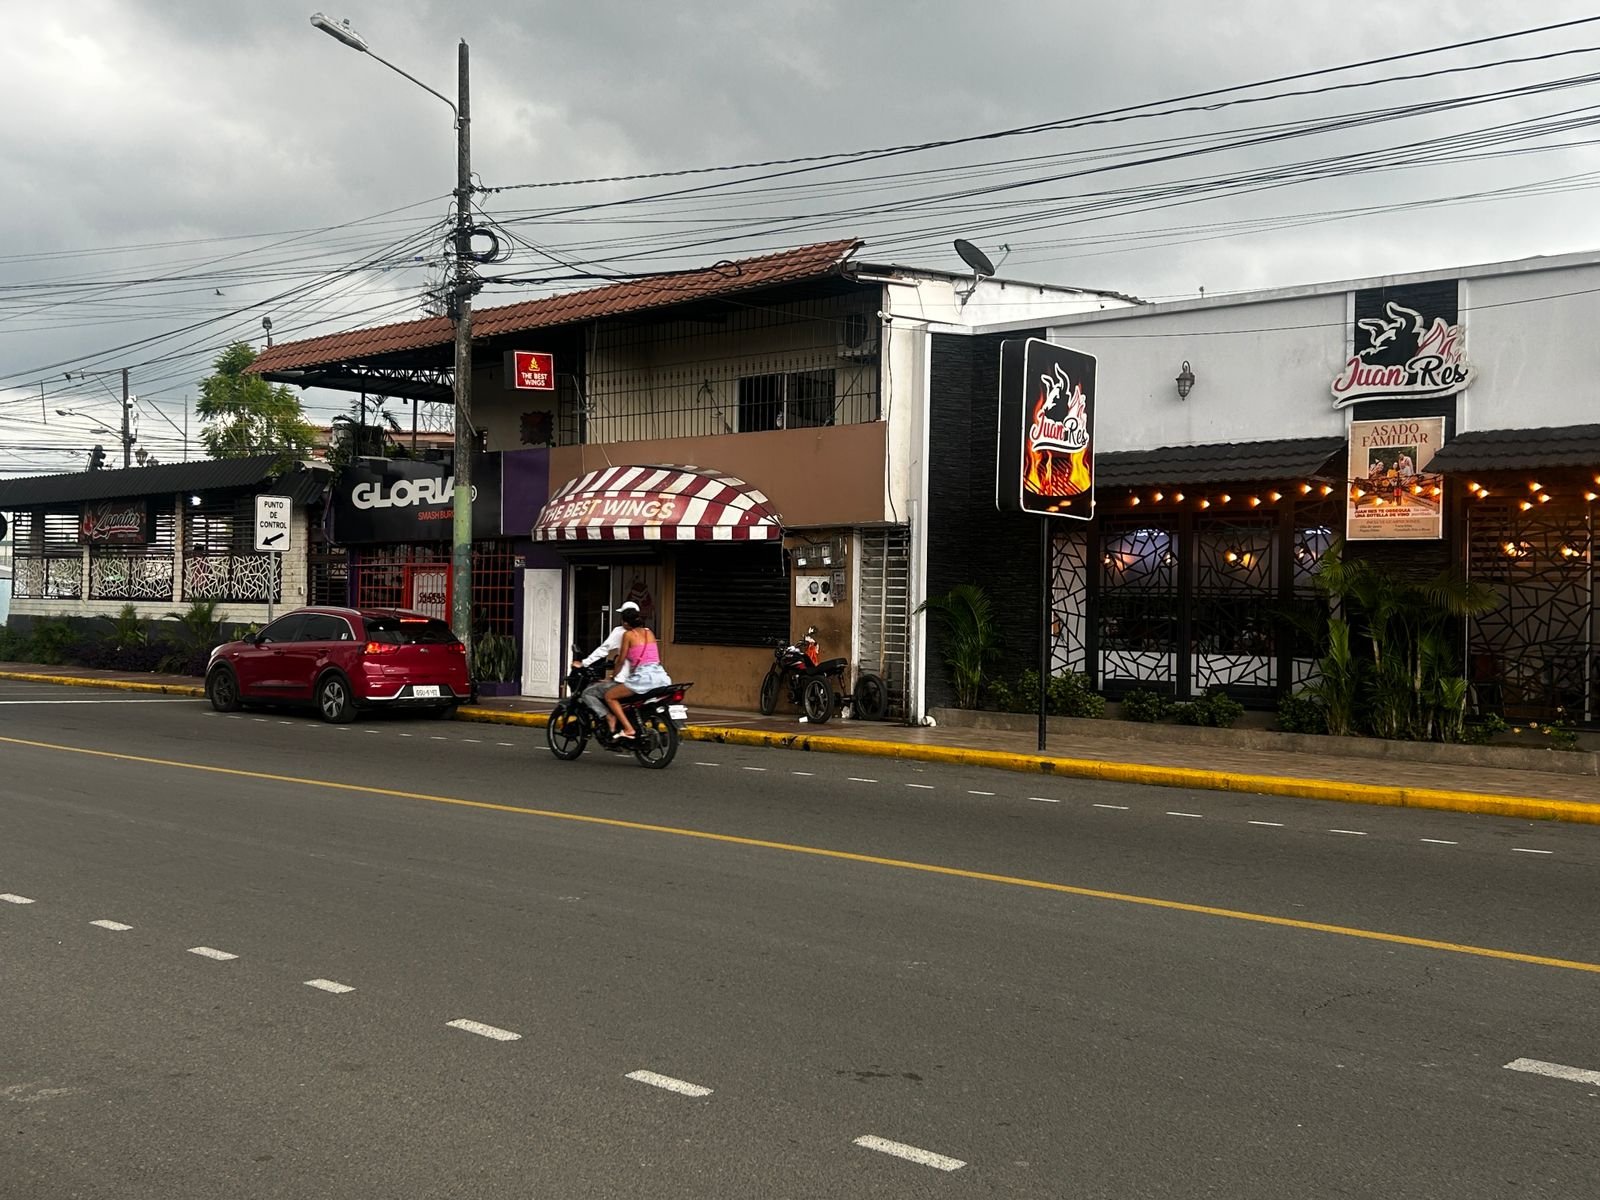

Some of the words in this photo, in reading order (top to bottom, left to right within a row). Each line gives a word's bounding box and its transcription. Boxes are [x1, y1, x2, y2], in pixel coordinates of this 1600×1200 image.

[1333, 357, 1402, 392] Juan
[1407, 355, 1469, 387] Res
[1031, 411, 1064, 440] Juan
[1063, 417, 1088, 446] Res
[1370, 423, 1419, 437] ASADO
[1362, 433, 1428, 447] FAMILIAR
[270, 511, 278, 519] DE
[417, 511, 440, 521] SMASH
[541, 505, 565, 524] THE
[563, 499, 602, 518] BEST
[602, 499, 677, 520] WINGS
[260, 521, 287, 529] CONTROL
